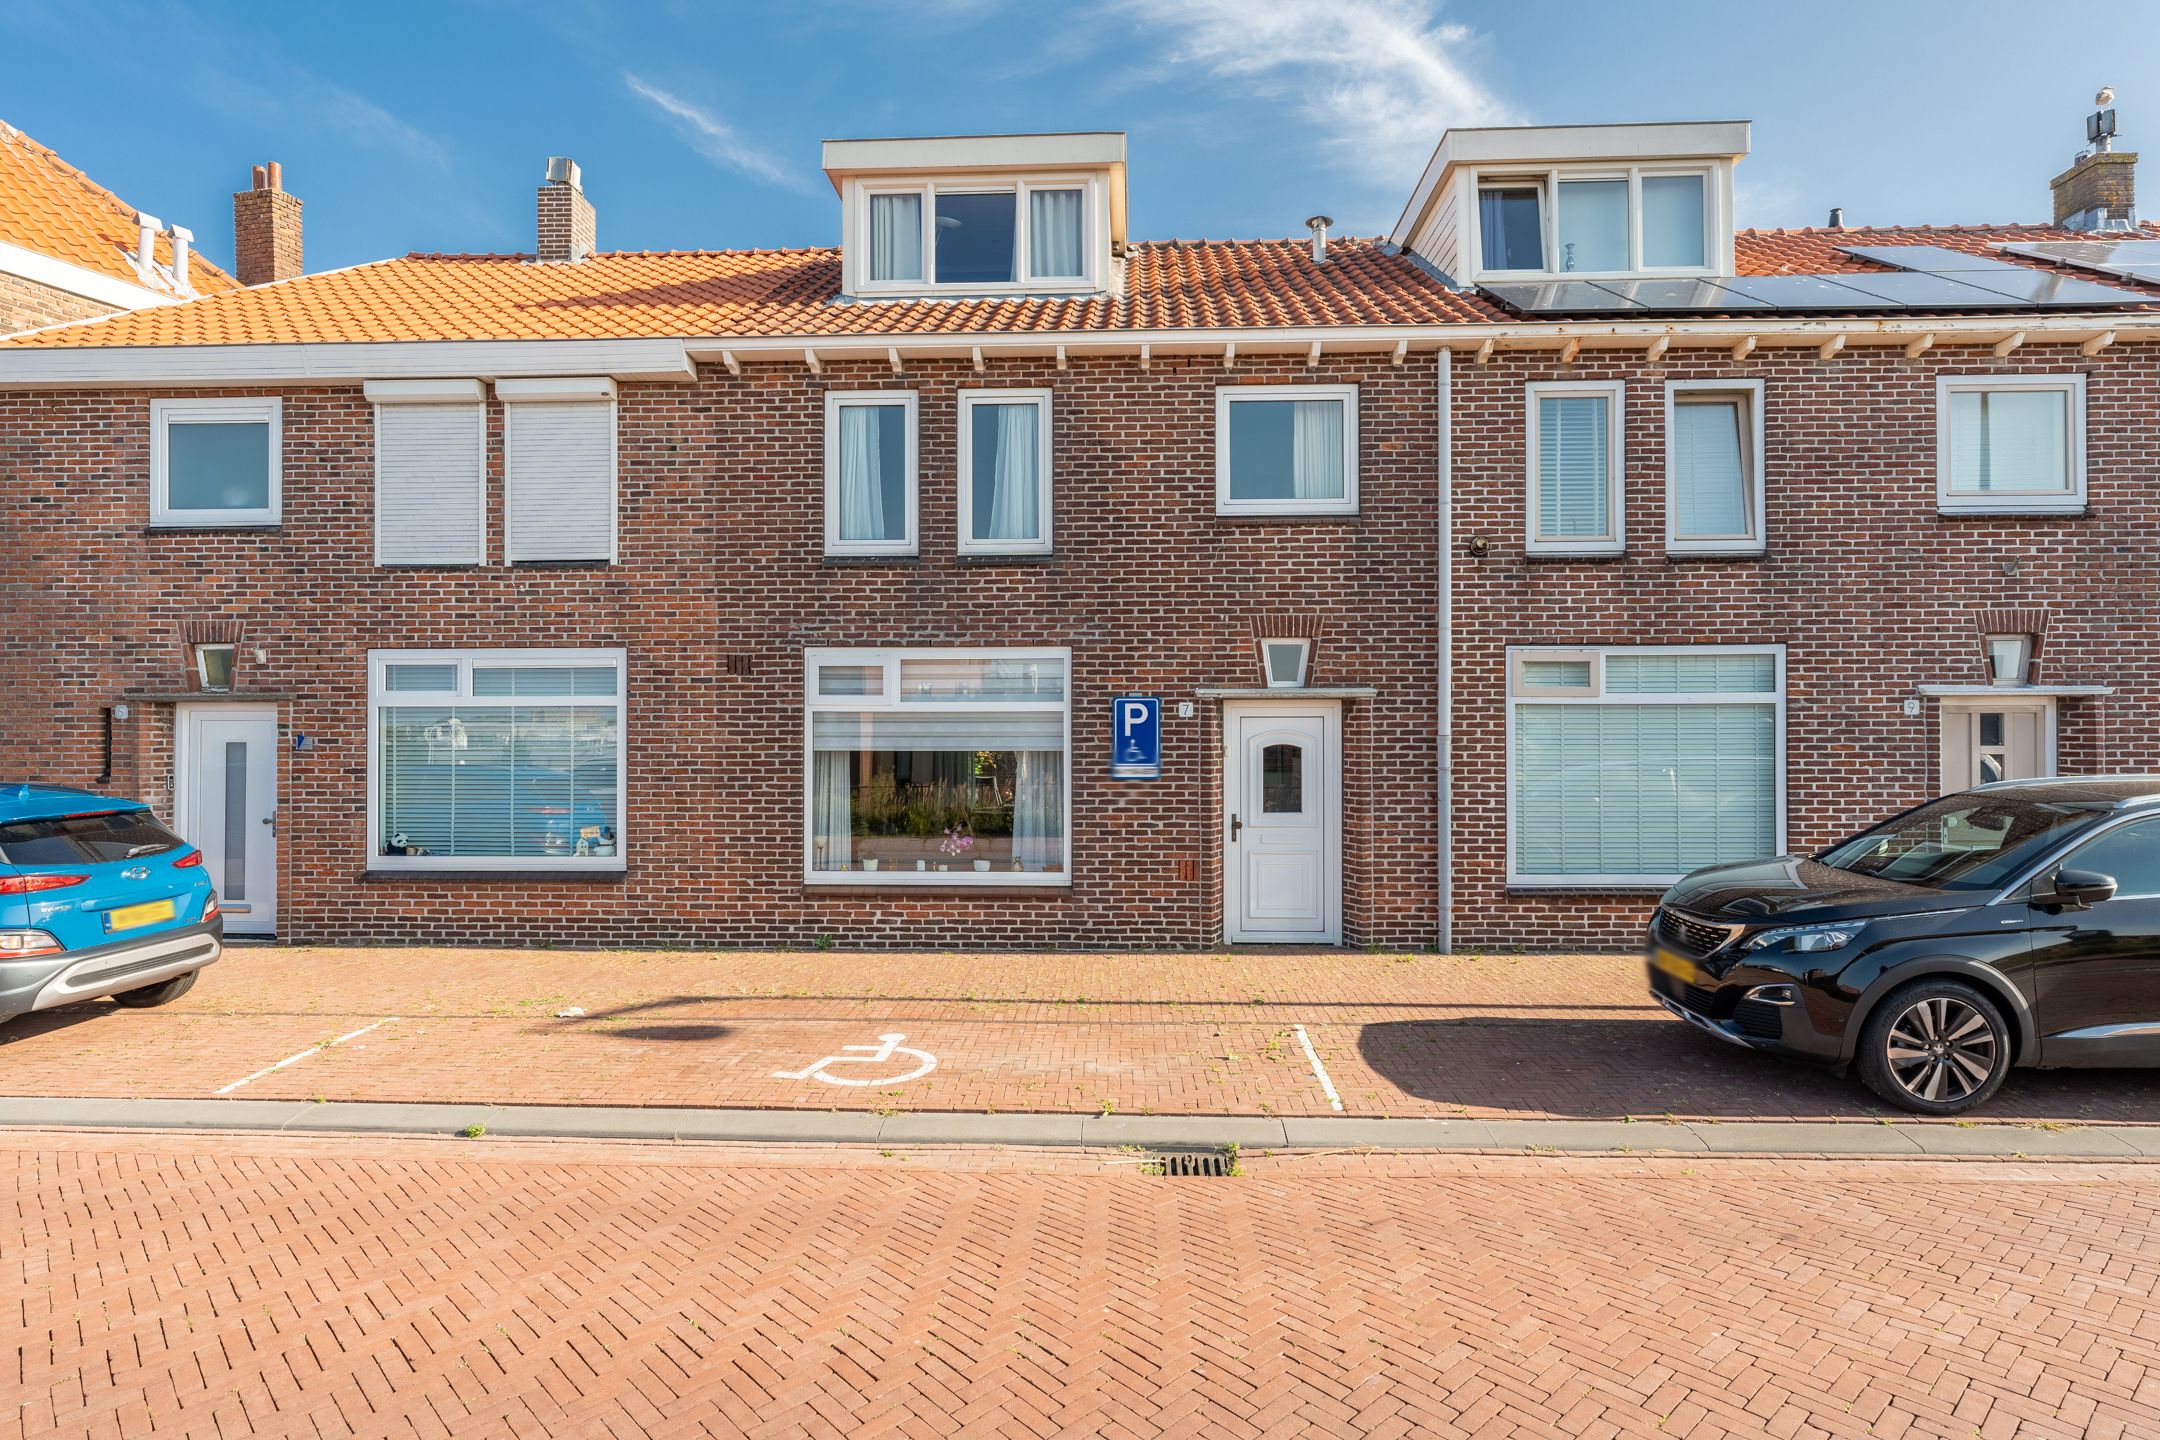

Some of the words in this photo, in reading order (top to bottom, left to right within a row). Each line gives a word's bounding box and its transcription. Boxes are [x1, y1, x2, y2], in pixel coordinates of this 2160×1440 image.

[1182, 704, 1190, 716] 7
[1907, 702, 1915, 713] 9
[1124, 703, 1149, 737] P
